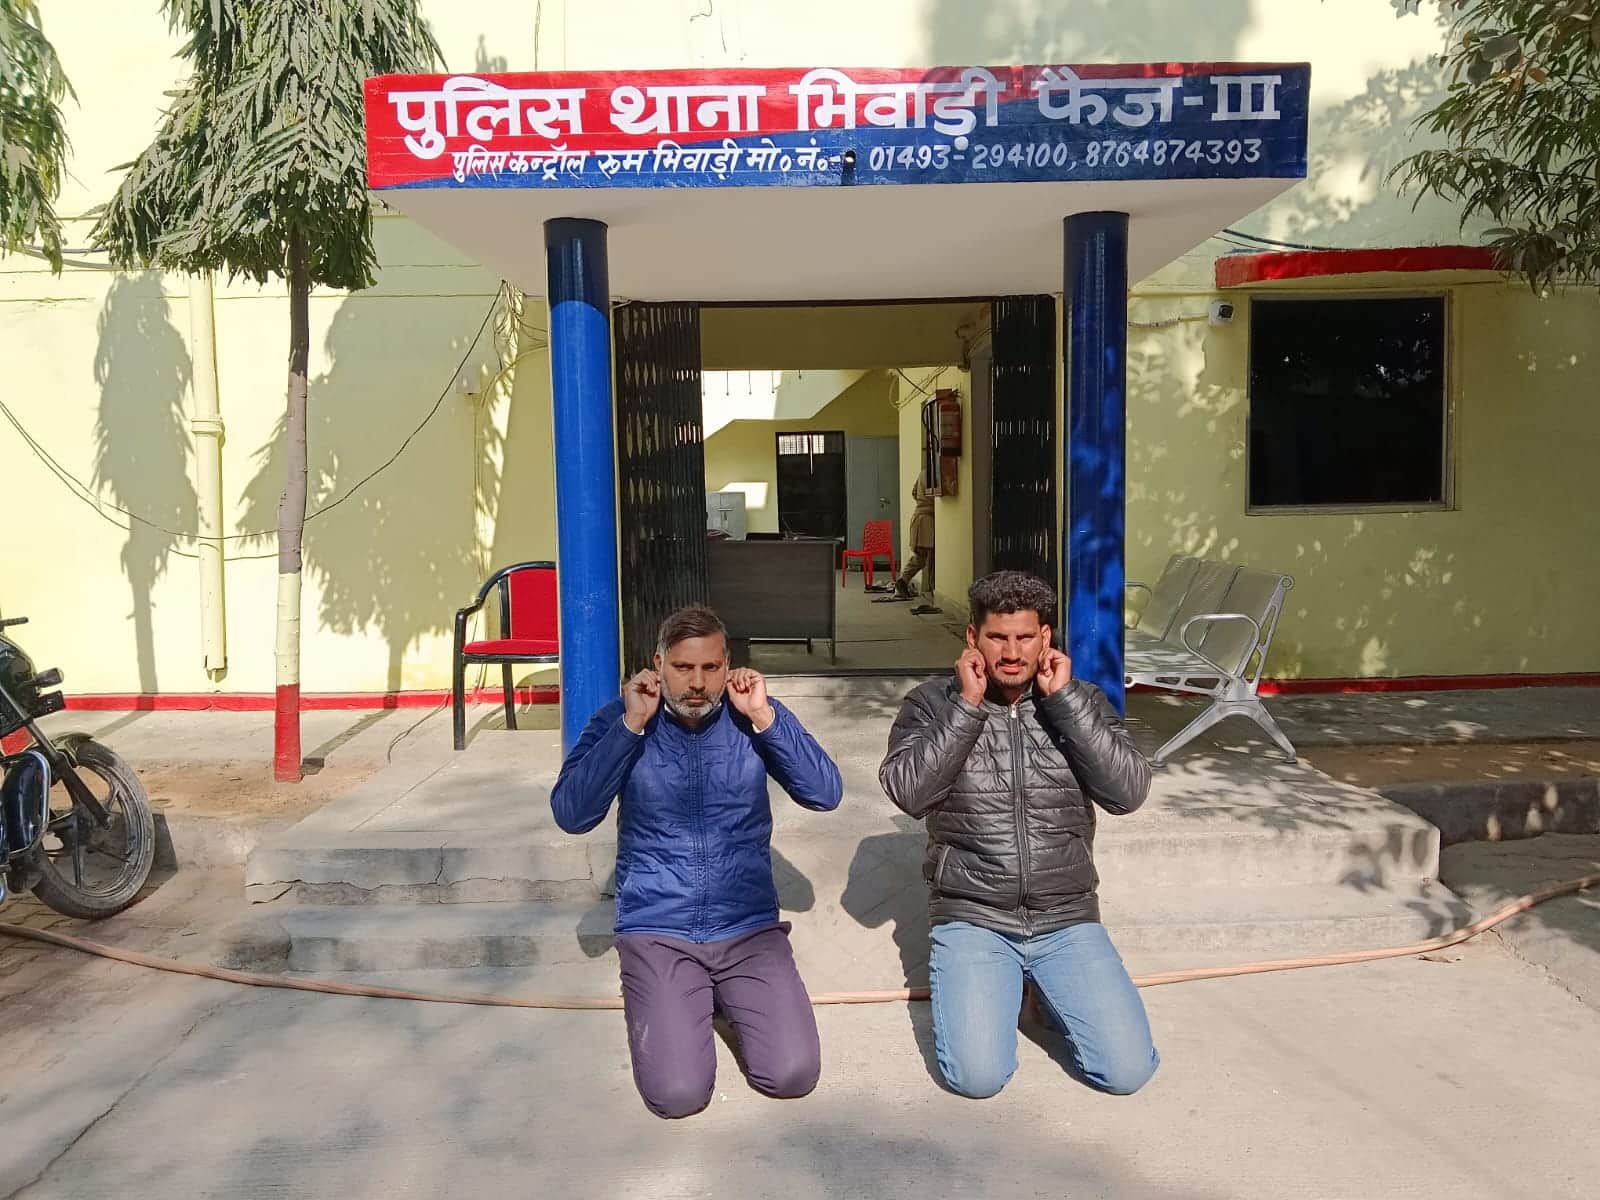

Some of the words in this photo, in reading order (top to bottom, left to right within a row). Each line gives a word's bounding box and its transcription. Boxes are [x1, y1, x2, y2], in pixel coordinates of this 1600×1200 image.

[388, 76, 586, 160] पुलिस
[610, 85, 767, 135] थाना
[788, 67, 1006, 150] भिवाड़ी
[451, 144, 510, 183] पुलिस
[653, 138, 743, 181] भिवाड़ी
[1085, 138, 1263, 167] 8764874393
